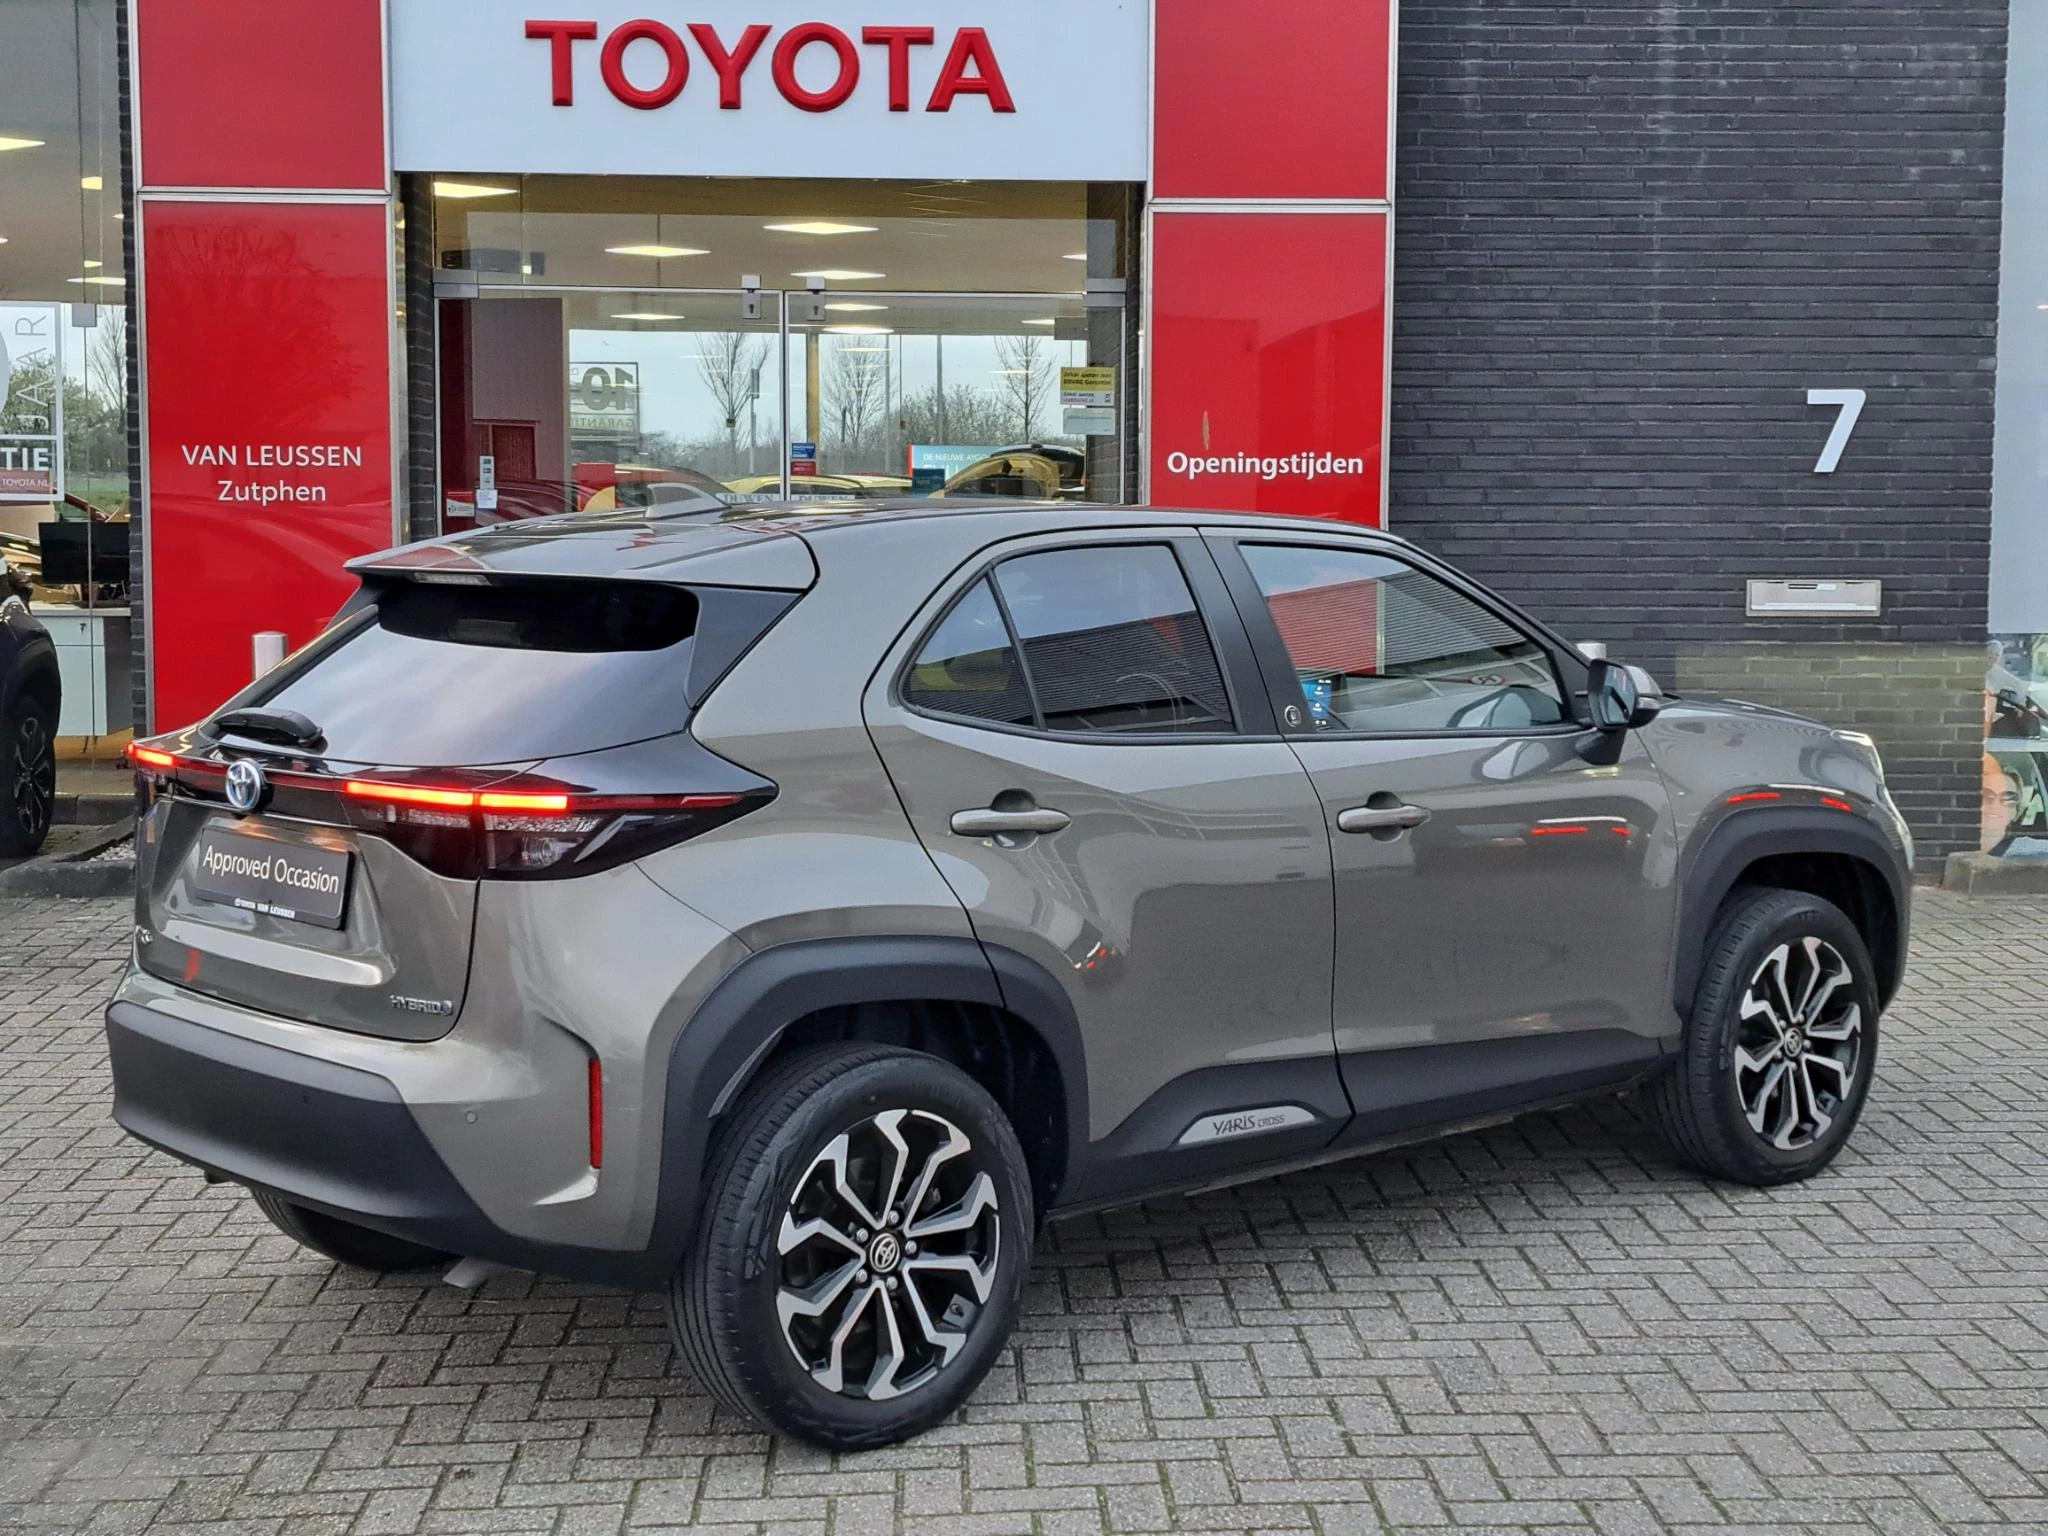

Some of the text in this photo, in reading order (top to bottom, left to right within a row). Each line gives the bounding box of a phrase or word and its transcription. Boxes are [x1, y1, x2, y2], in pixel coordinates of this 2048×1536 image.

[525, 19, 1016, 113] TOYOTA
[15, 314, 49, 429] JAAR
[1806, 389, 1866, 473] 7
[181, 445, 362, 467] VAN LEUSSEN
[1167, 451, 1364, 480] Openingstijden
[217, 480, 326, 507] Zutphen
[203, 845, 340, 894] Approved Occasion
[390, 995, 441, 1013] HYBRID
[1213, 1115, 1286, 1135] YARIS CROSS
